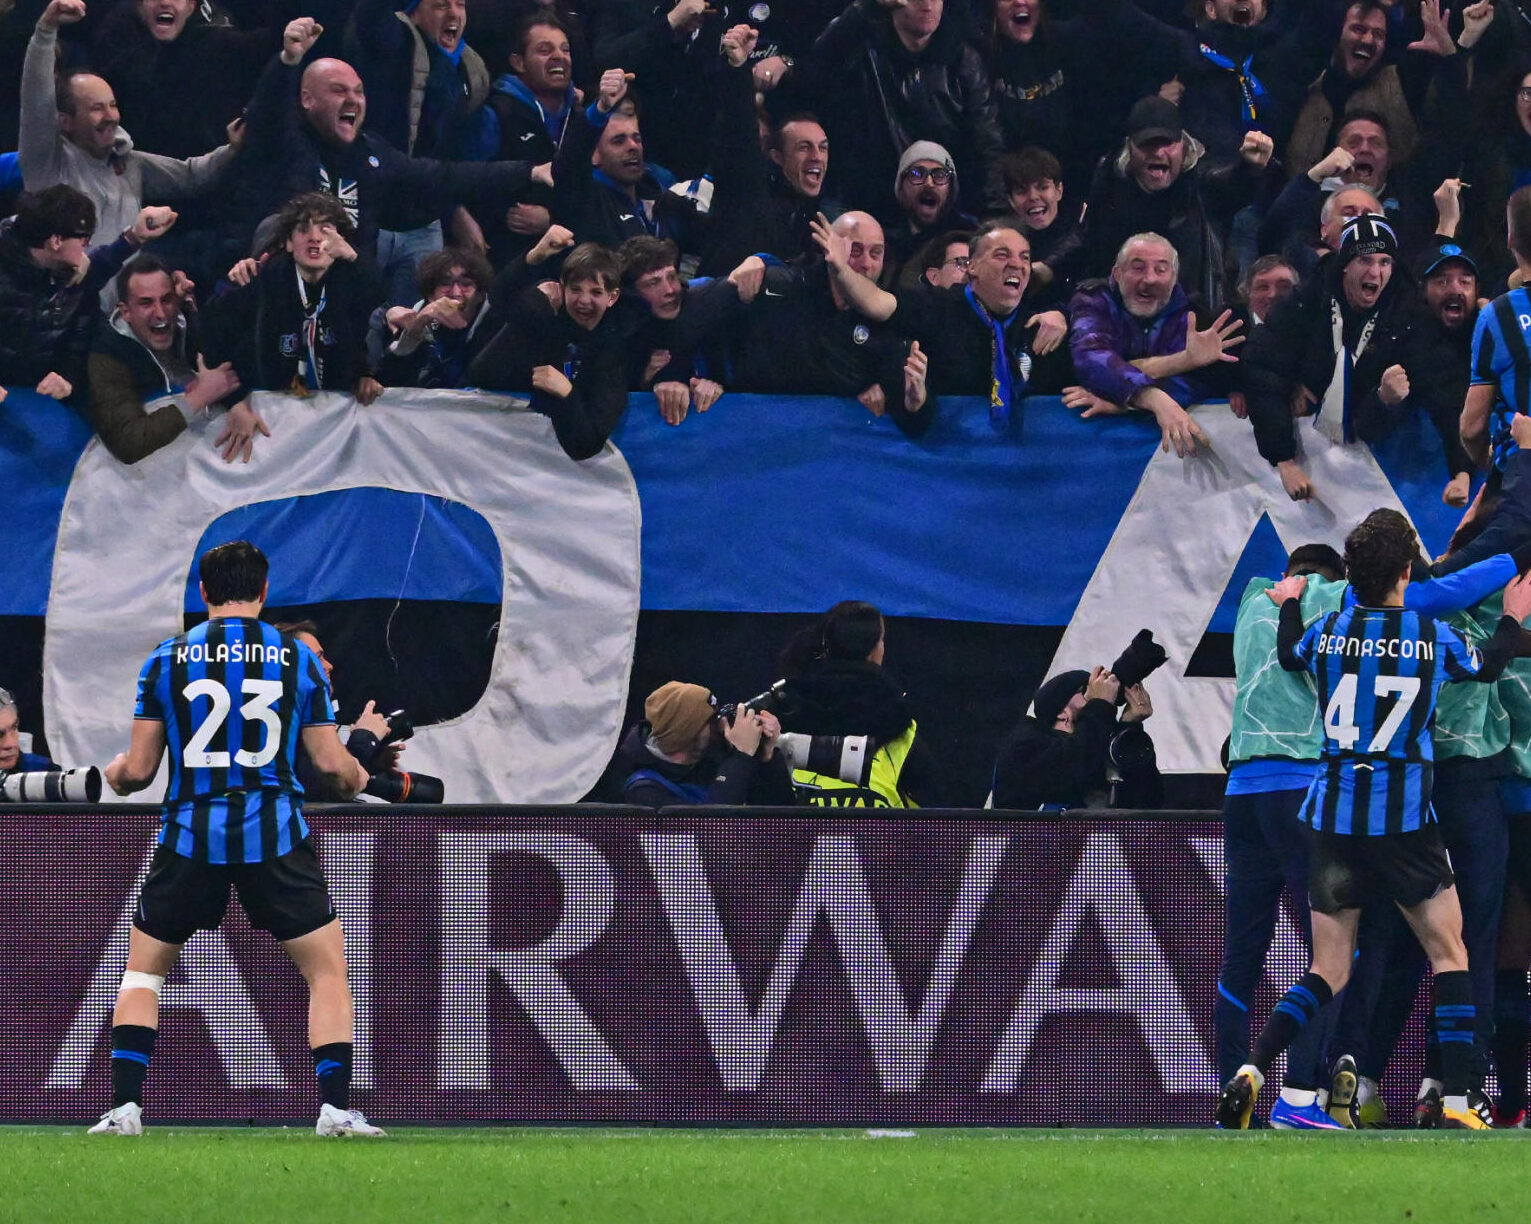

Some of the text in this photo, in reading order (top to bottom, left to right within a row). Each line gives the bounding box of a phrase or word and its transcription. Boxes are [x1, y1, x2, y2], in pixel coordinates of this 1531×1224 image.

[176, 639, 291, 667] KOLAŠINAC
[1317, 634, 1434, 661] BERNASCONI
[182, 678, 284, 768] 23
[1324, 673, 1421, 752] 47
